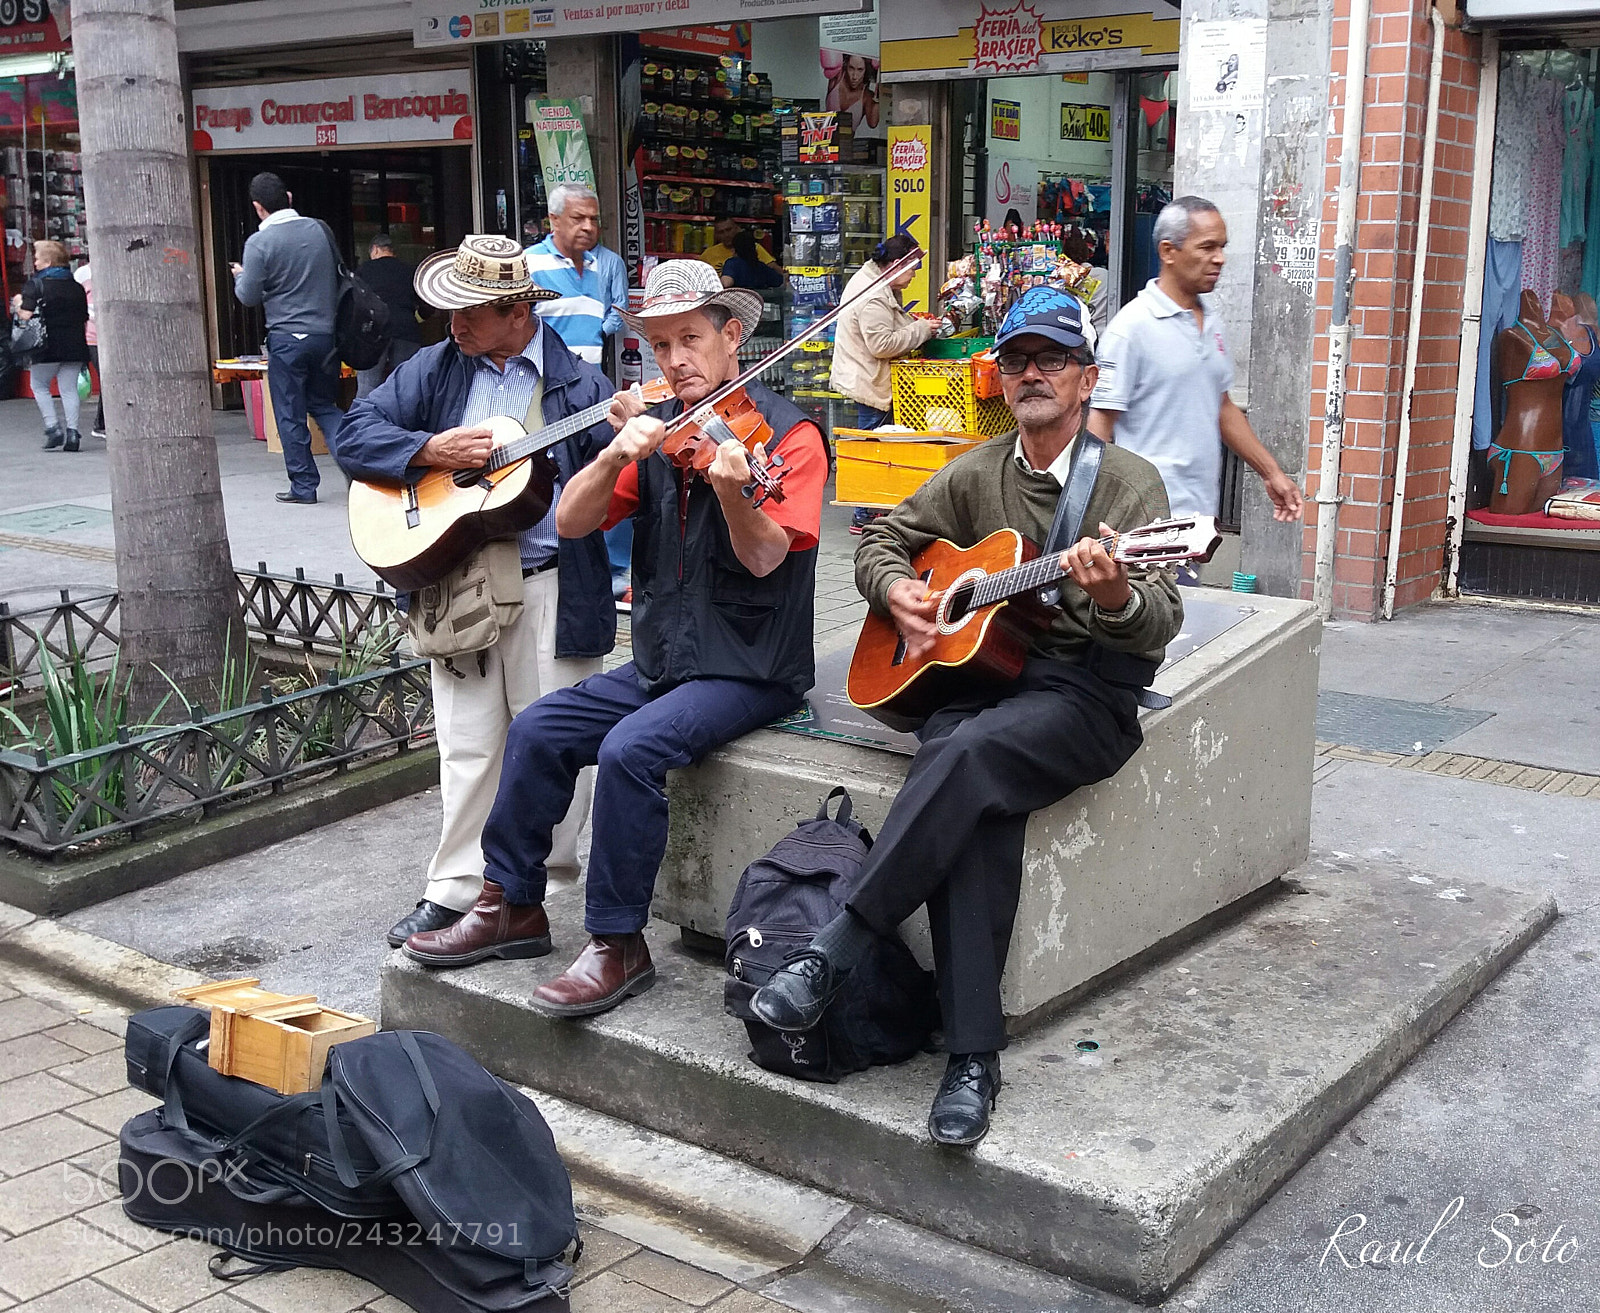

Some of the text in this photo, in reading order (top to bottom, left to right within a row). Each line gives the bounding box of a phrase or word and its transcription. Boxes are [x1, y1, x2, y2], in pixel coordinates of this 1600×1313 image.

[563, 8, 594, 20] Ventas
[596, 5, 604, 18] al
[606, 6, 623, 19] por
[625, 2, 655, 15] mayor
[656, 1, 663, 14] y
[536, 14, 552, 23] VISA
[981, 16, 1037, 38] FERIA del
[1055, 24, 1078, 33] SOLO
[980, 37, 1037, 60] BRASIER
[261, 95, 354, 125] Comercial
[364, 89, 468, 122] Bancoquia
[540, 106, 573, 117] TIENDA
[535, 120, 583, 131] NATURISTA
[317, 130, 336, 144] 53-19
[801, 124, 837, 145] TNT
[895, 143, 916, 154] FERIA
[894, 154, 924, 166] BRASIER
[894, 178, 925, 193] SOLO
[798, 283, 826, 292] GAINER
